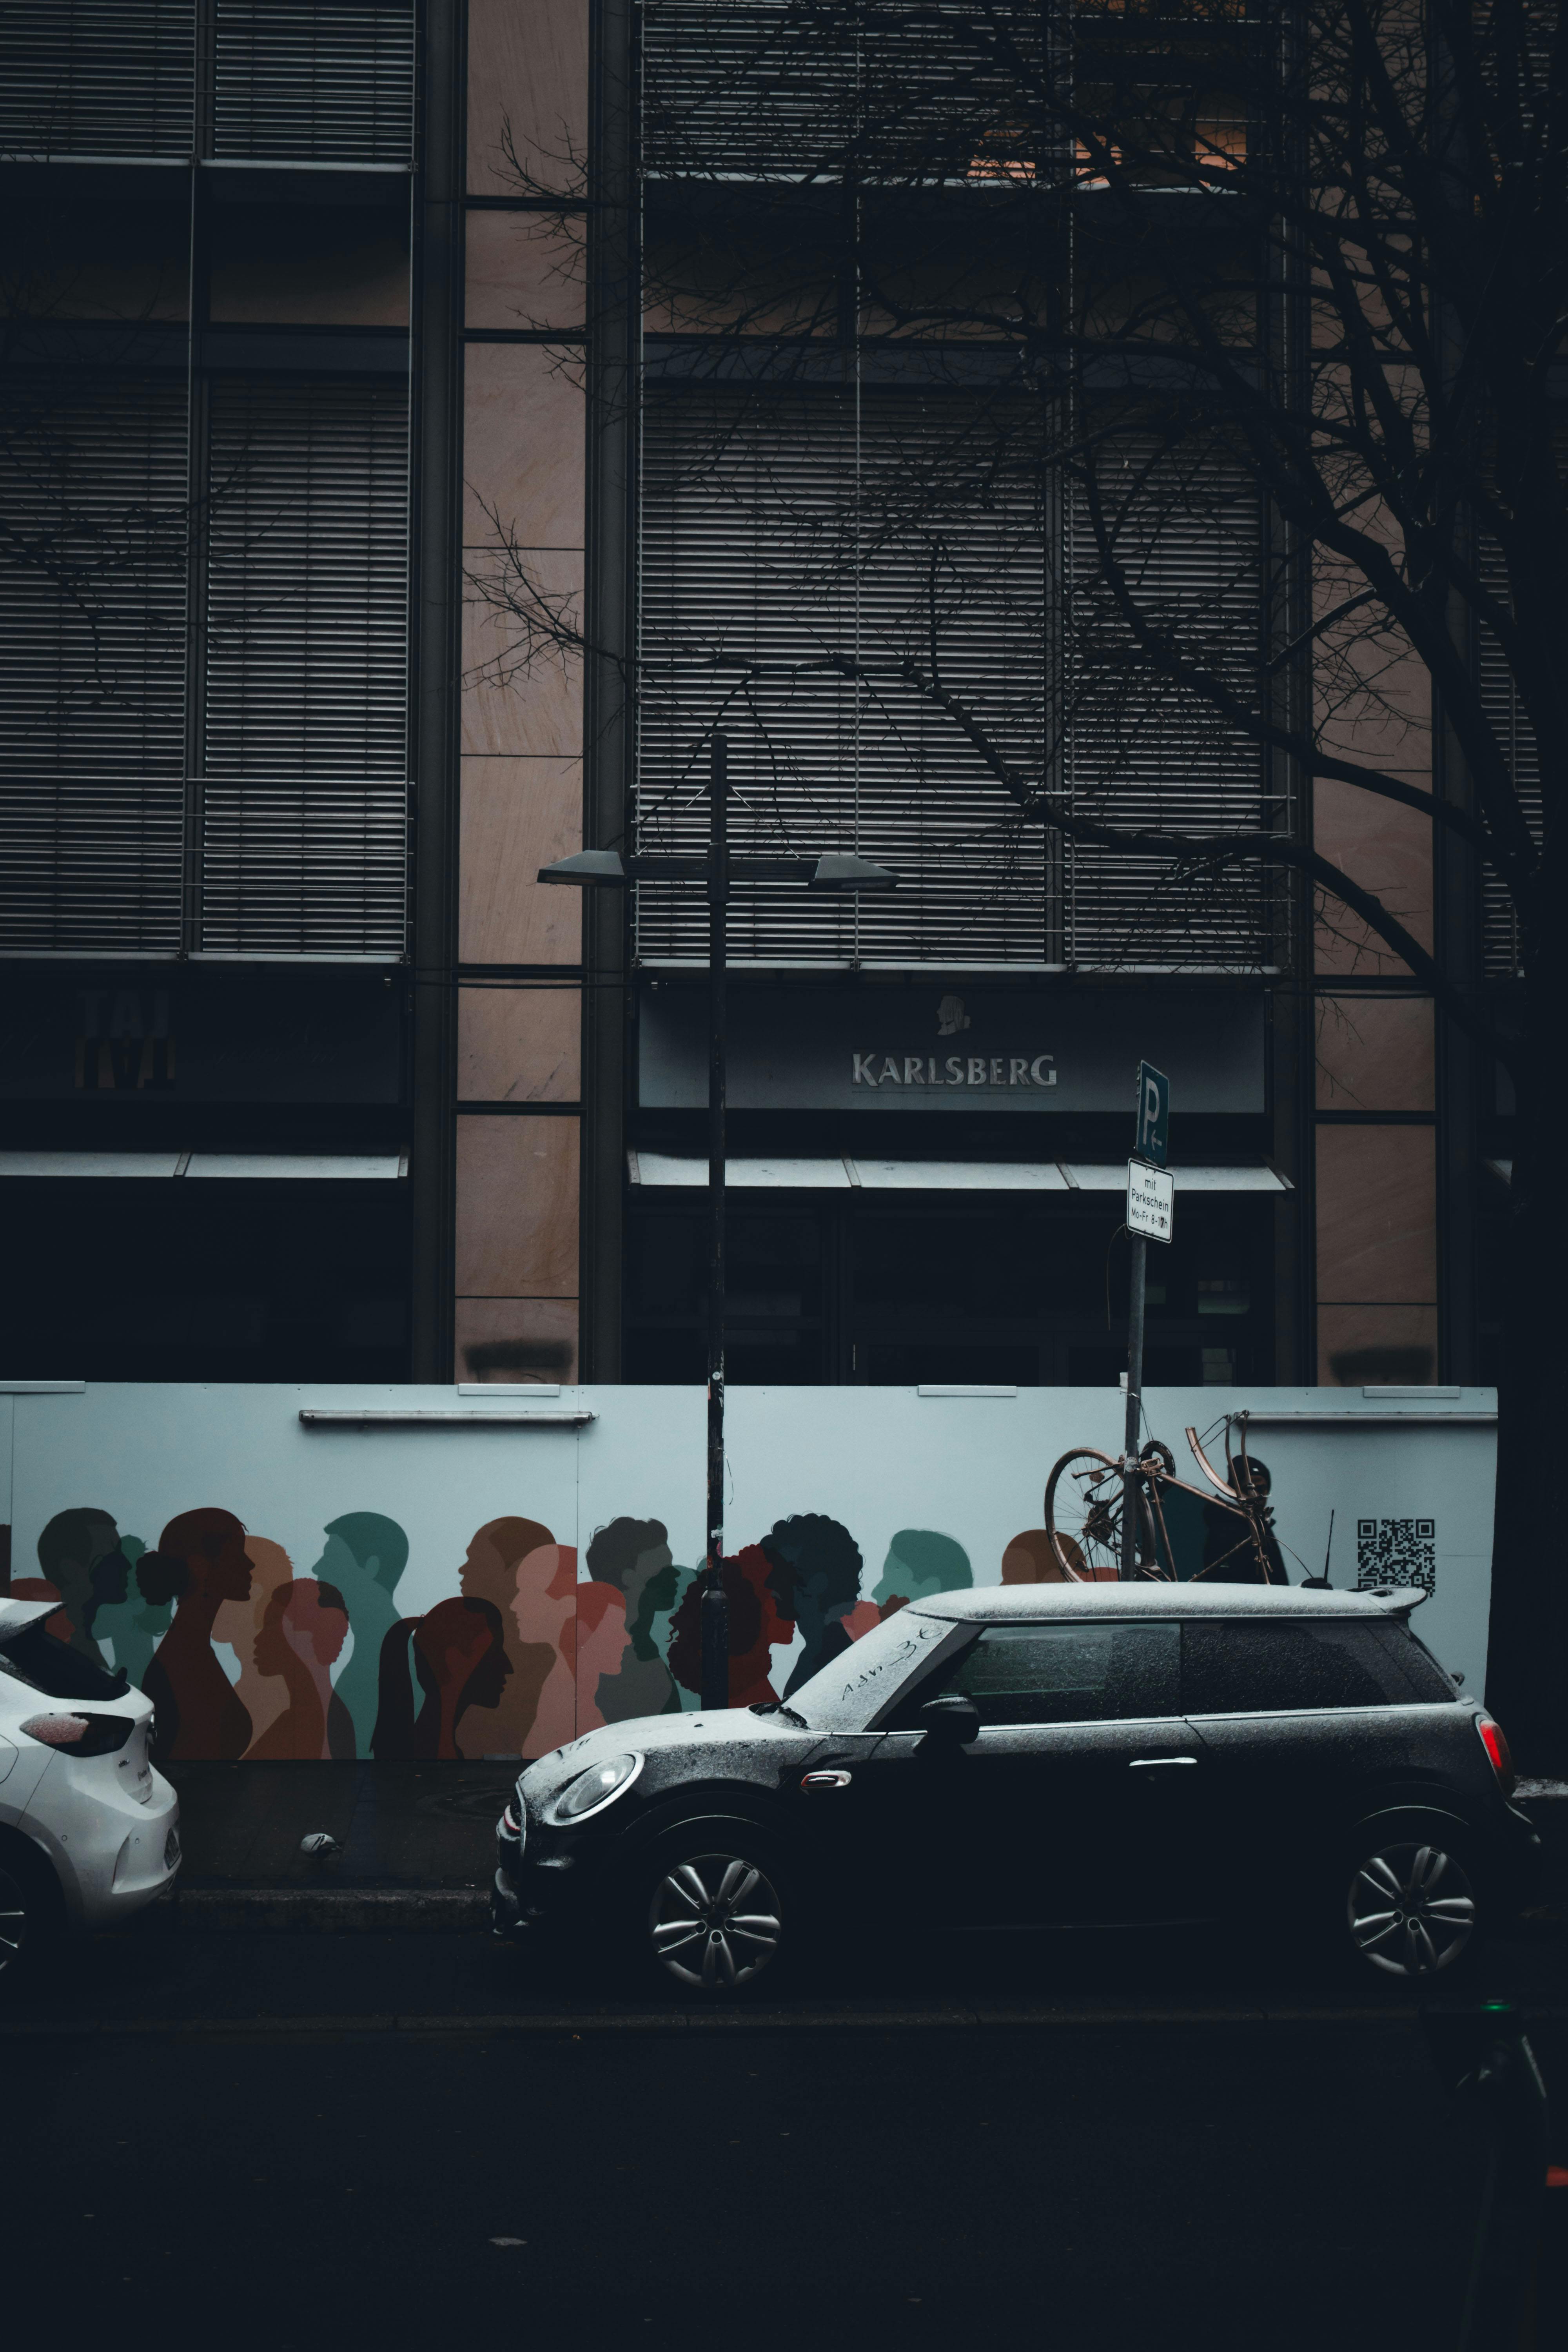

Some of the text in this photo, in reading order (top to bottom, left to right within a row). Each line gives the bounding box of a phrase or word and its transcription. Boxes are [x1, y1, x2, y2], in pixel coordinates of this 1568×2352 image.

[78, 990, 169, 1038] TAJ
[852, 1054, 1056, 1086] KARLSBERG
[1143, 1076, 1160, 1145] P
[1145, 1178, 1156, 1191] mit
[1132, 1188, 1168, 1212] Parkschein
[1131, 1207, 1168, 1229] Mo-Fr 8-17h
